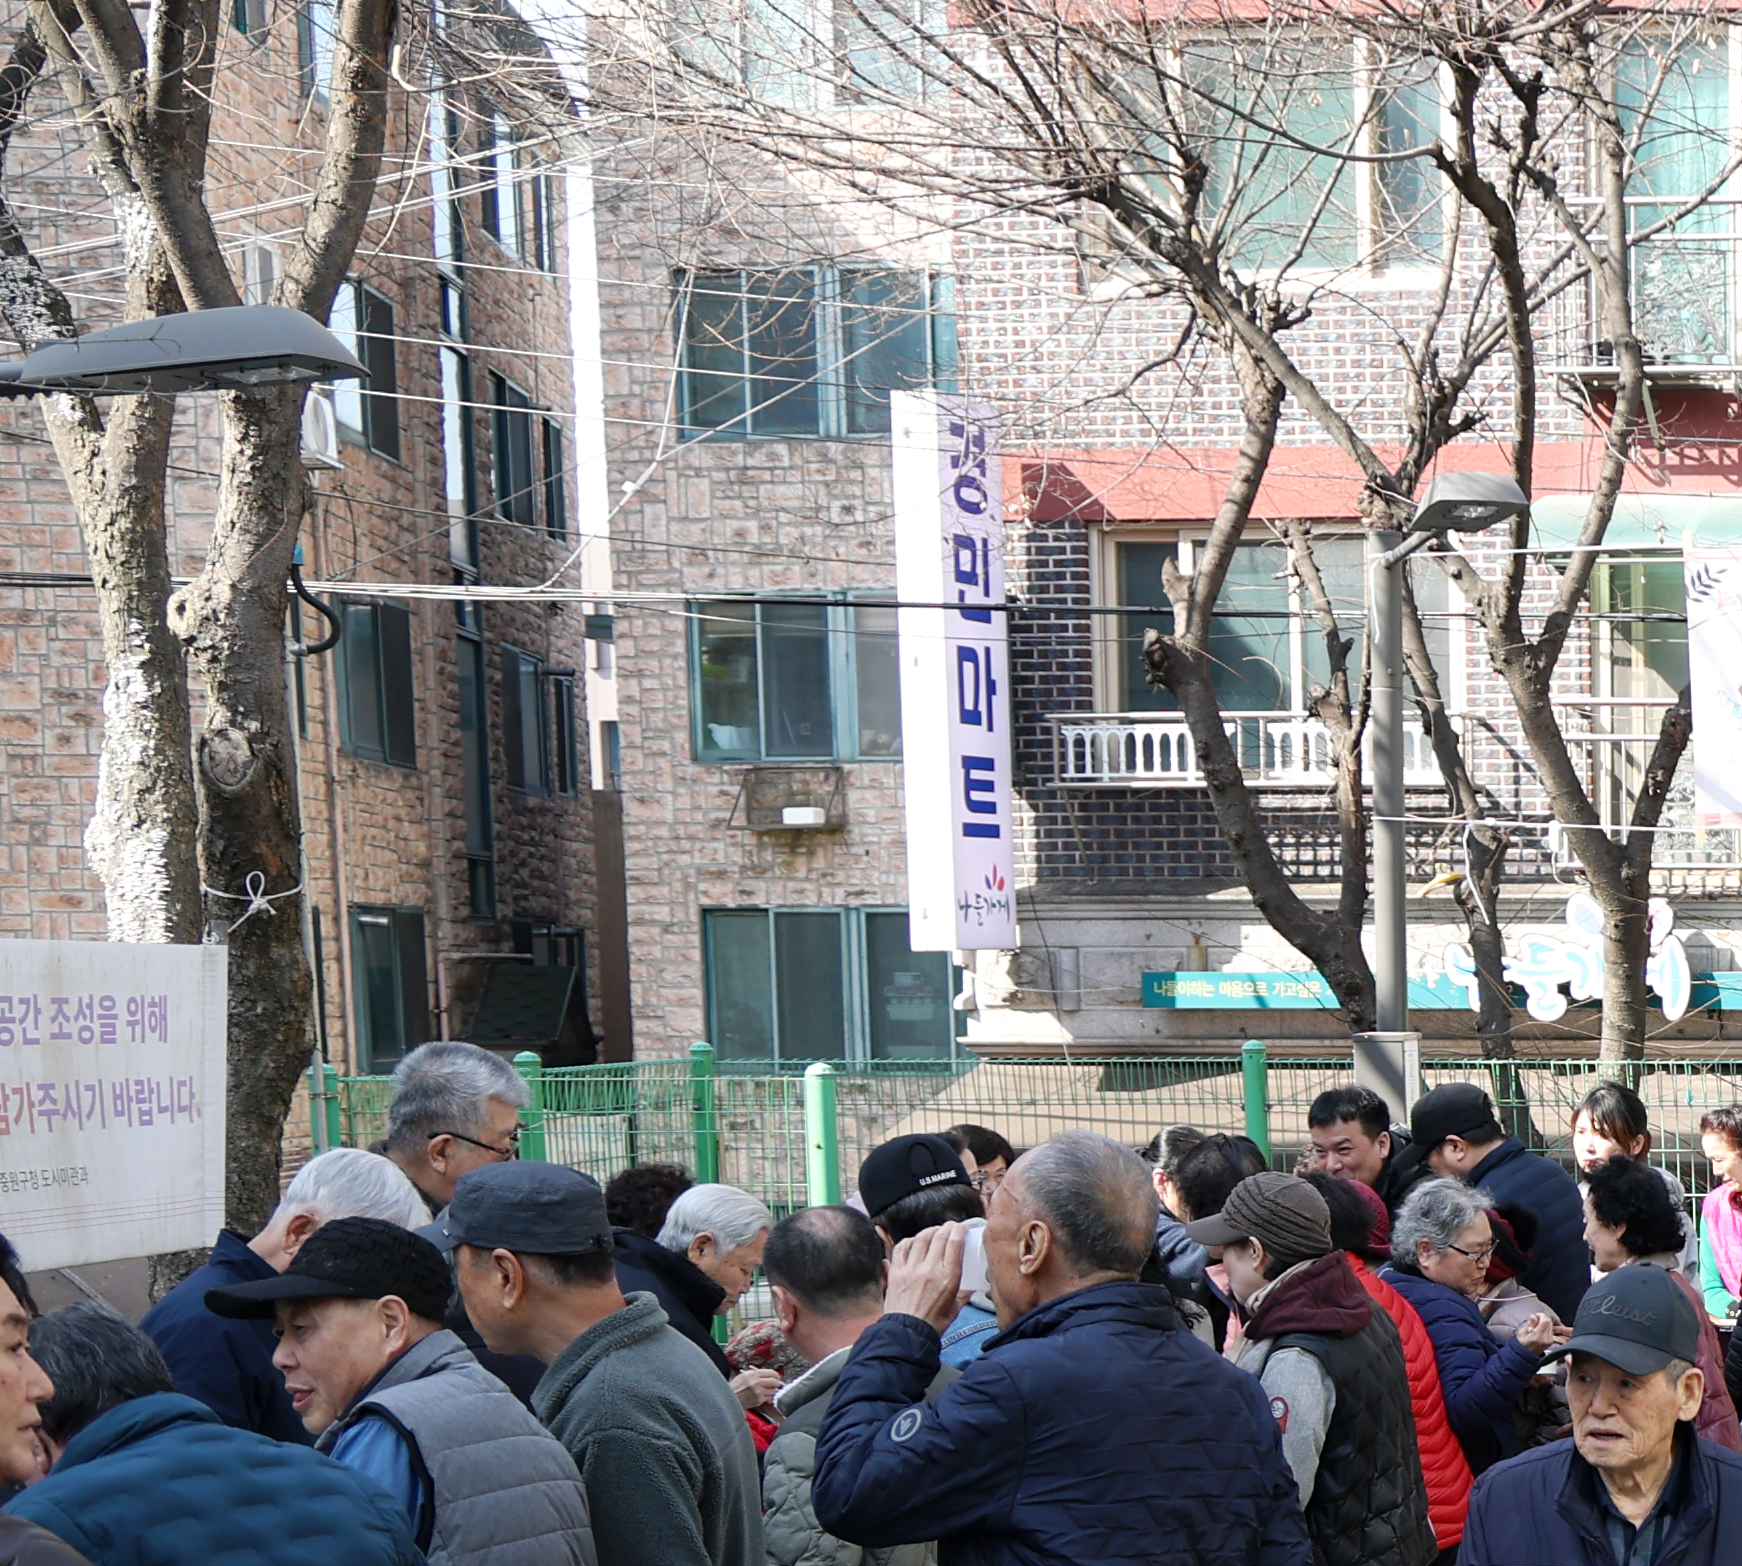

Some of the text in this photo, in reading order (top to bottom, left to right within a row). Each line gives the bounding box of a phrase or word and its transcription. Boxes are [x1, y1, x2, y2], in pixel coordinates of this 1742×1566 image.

[1218, 980, 1268, 997] 마음으로
[50, 993, 119, 1045] 조성을
[126, 994, 168, 1044] 위해
[111, 1075, 202, 1128] 바랍니다.
